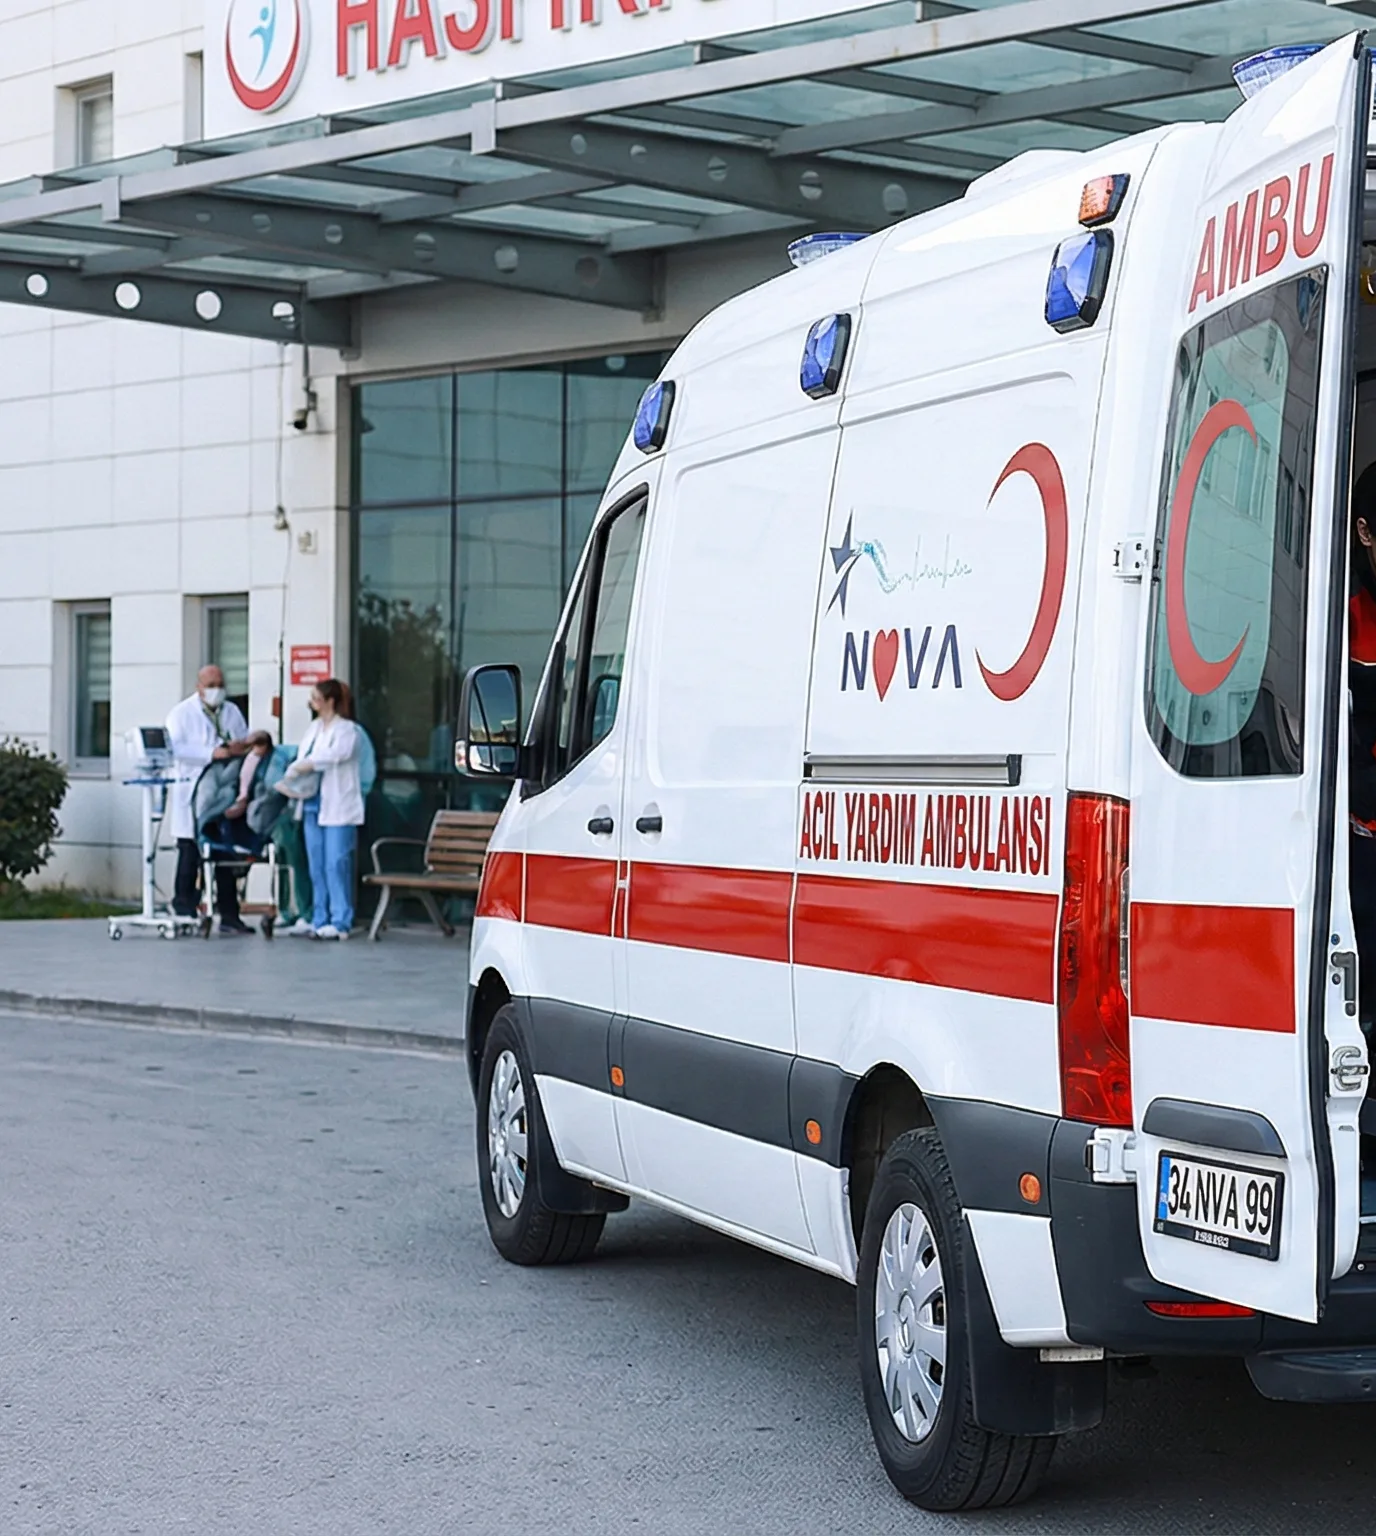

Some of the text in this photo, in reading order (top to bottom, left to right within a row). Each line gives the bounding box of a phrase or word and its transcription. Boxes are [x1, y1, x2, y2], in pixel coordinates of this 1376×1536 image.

[1188, 153, 1334, 314] AMBU
[845, 792, 916, 865] YARDIM
[920, 794, 1051, 876] AMBULANSI
[1168, 1165, 1273, 1235] 34 NVA 99
